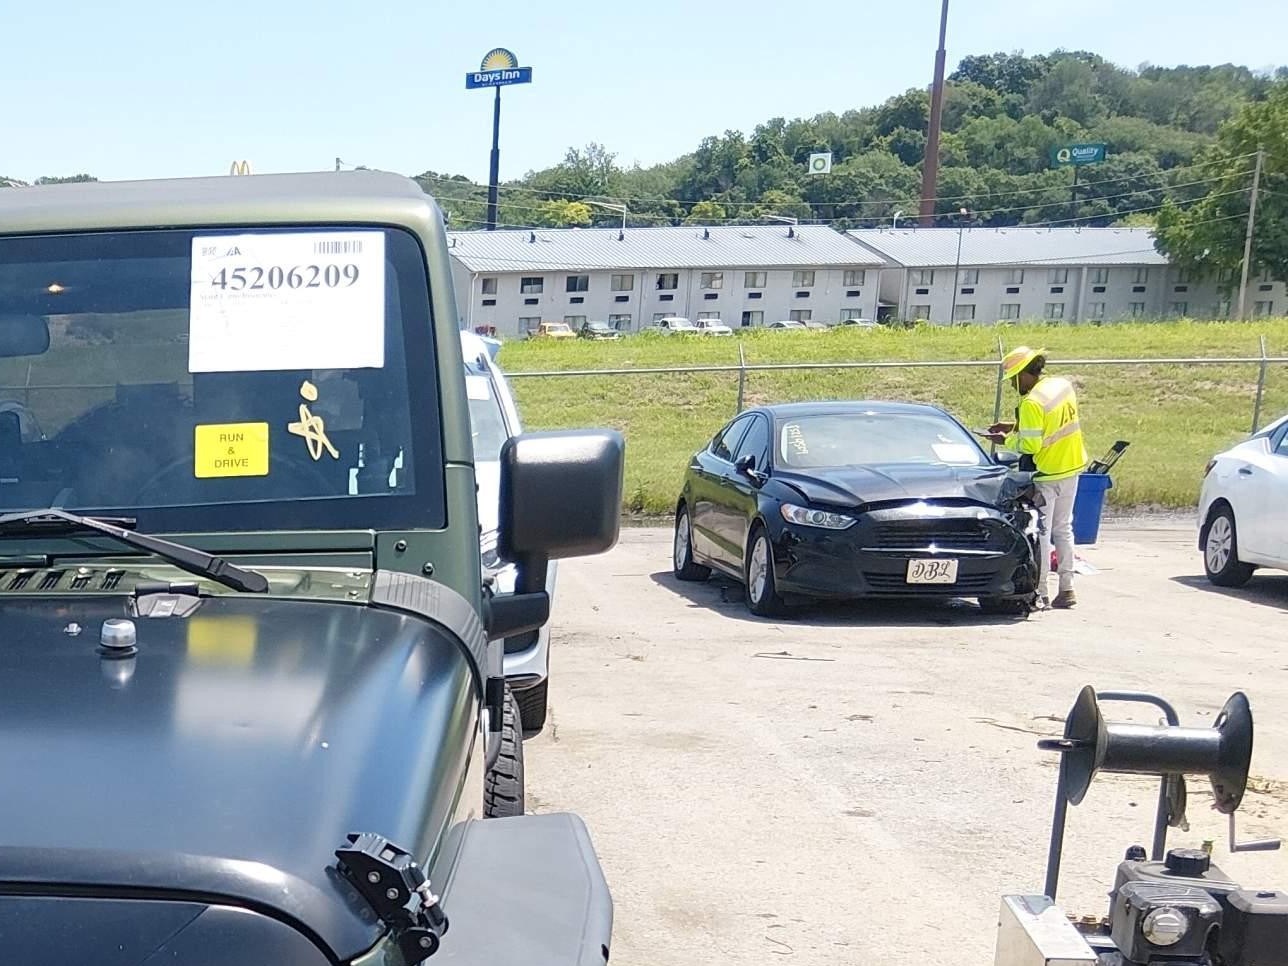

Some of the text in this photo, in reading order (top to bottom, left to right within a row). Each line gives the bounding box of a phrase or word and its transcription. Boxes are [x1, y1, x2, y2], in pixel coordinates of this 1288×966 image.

[474, 70, 520, 83] Days Inn
[1071, 146, 1099, 157] Quality
[211, 263, 360, 291] 45206209
[219, 433, 244, 443] RUN
[227, 446, 235, 455] &
[214, 458, 249, 469] DRIVE
